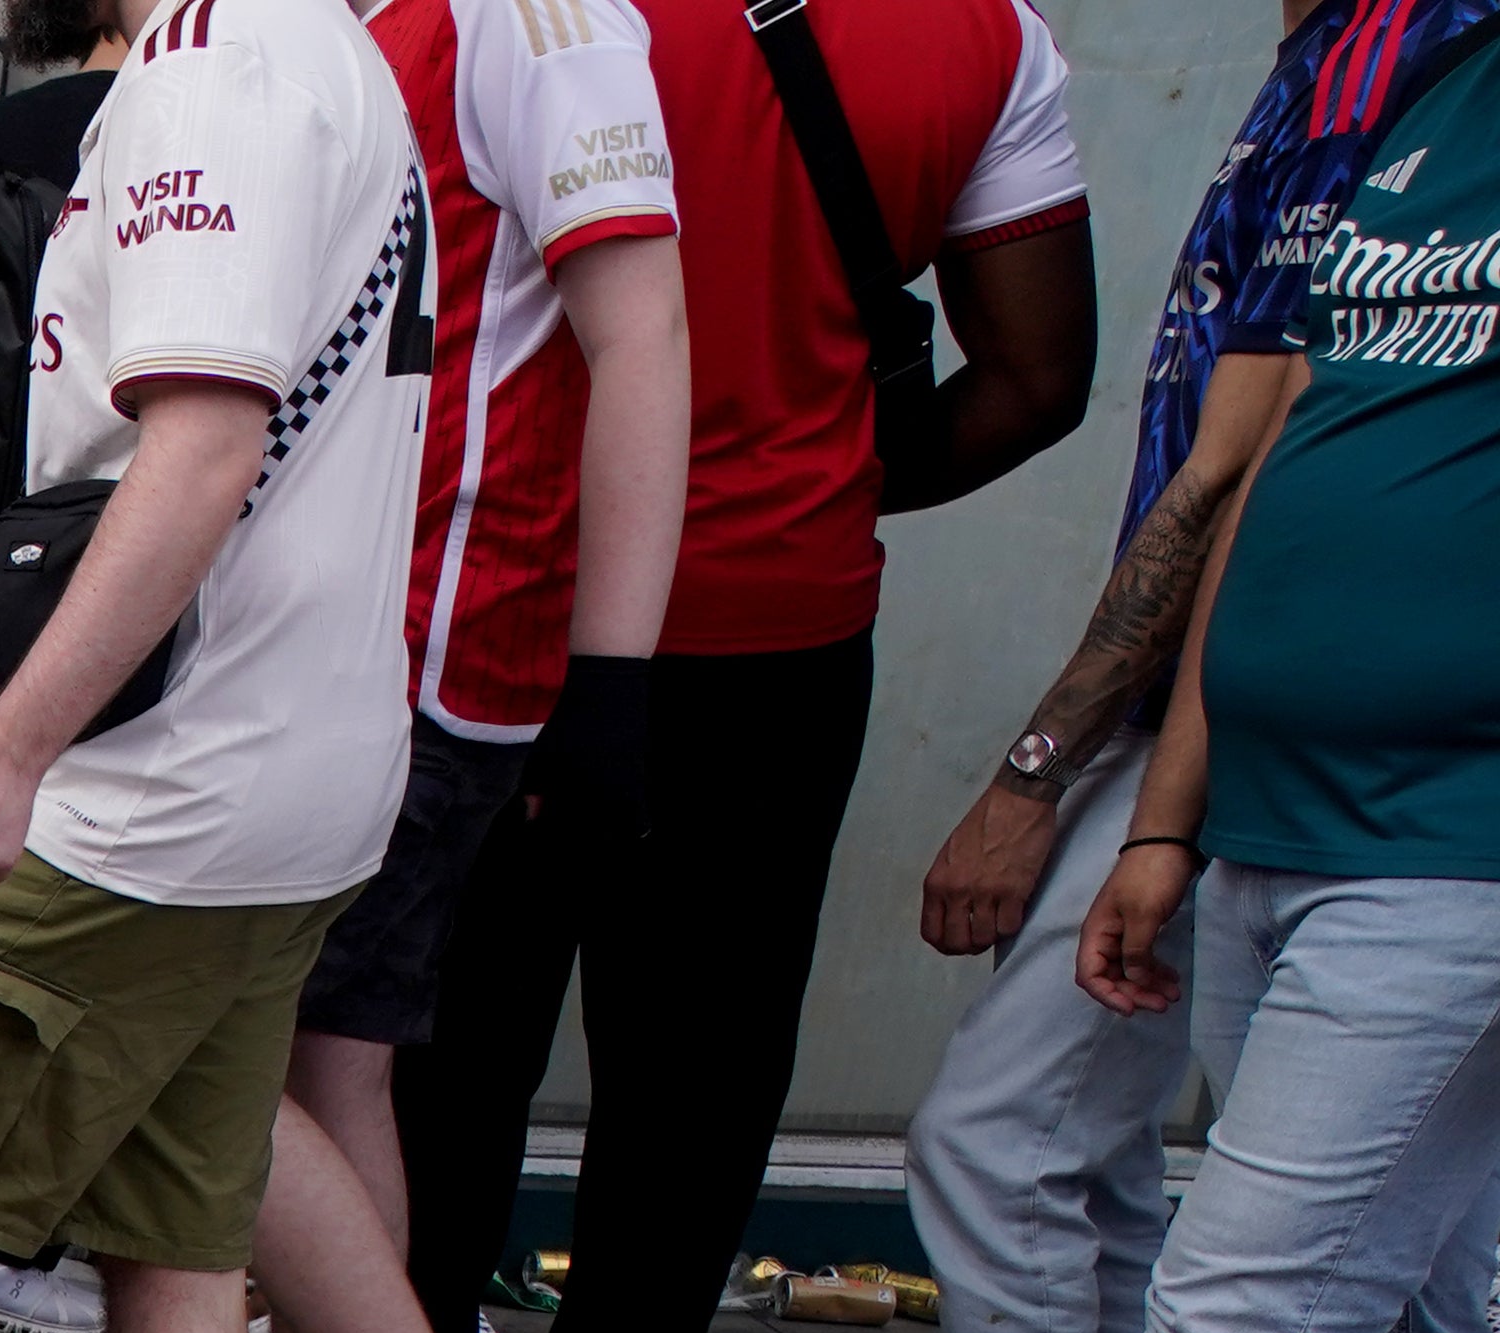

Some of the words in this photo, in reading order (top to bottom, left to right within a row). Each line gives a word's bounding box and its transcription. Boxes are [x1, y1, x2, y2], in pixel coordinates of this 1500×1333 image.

[575, 122, 647, 156] VISIT
[127, 170, 203, 210] VISIT
[548, 153, 670, 200] RWANDA
[117, 204, 236, 248] WANDA
[1309, 221, 1500, 298] Emirat
